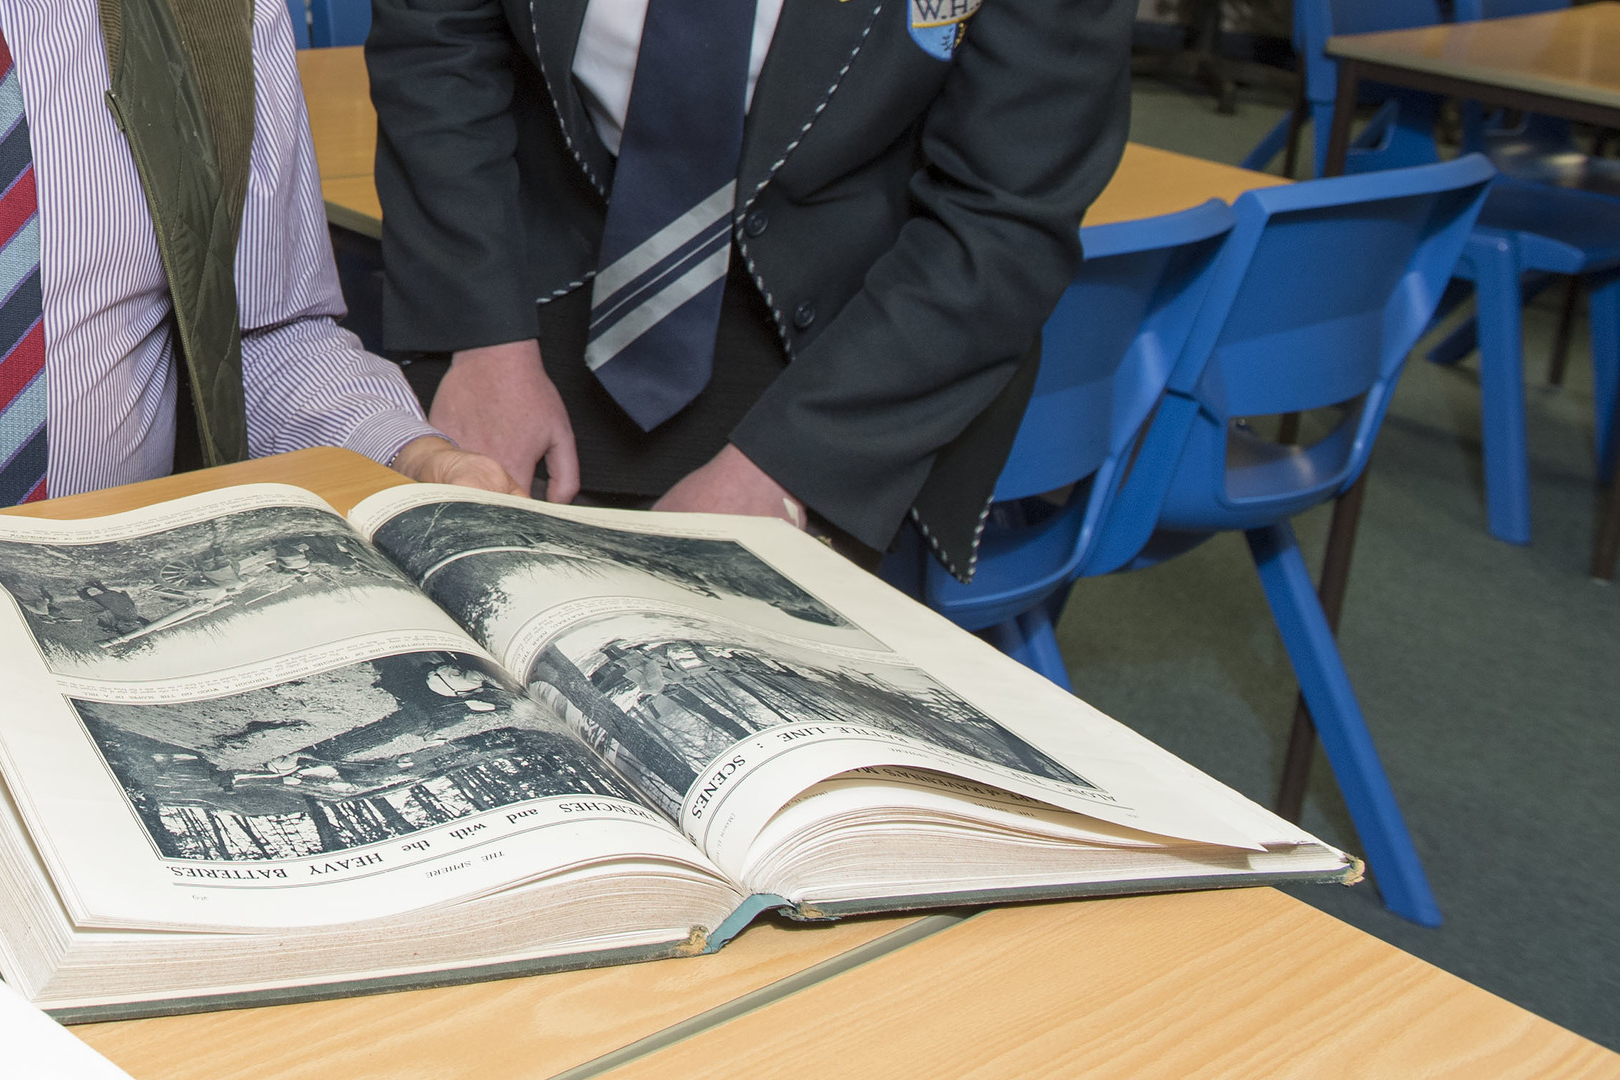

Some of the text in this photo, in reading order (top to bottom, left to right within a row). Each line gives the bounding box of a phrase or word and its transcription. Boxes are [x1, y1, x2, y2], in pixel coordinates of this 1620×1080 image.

[776, 724, 909, 744] BATTLE-LINE
[691, 755, 746, 819] SCENES
[165, 801, 661, 881] TRENCHES and with the HEAVY BATTERIES.
[425, 850, 504, 879] THE SPHERE
